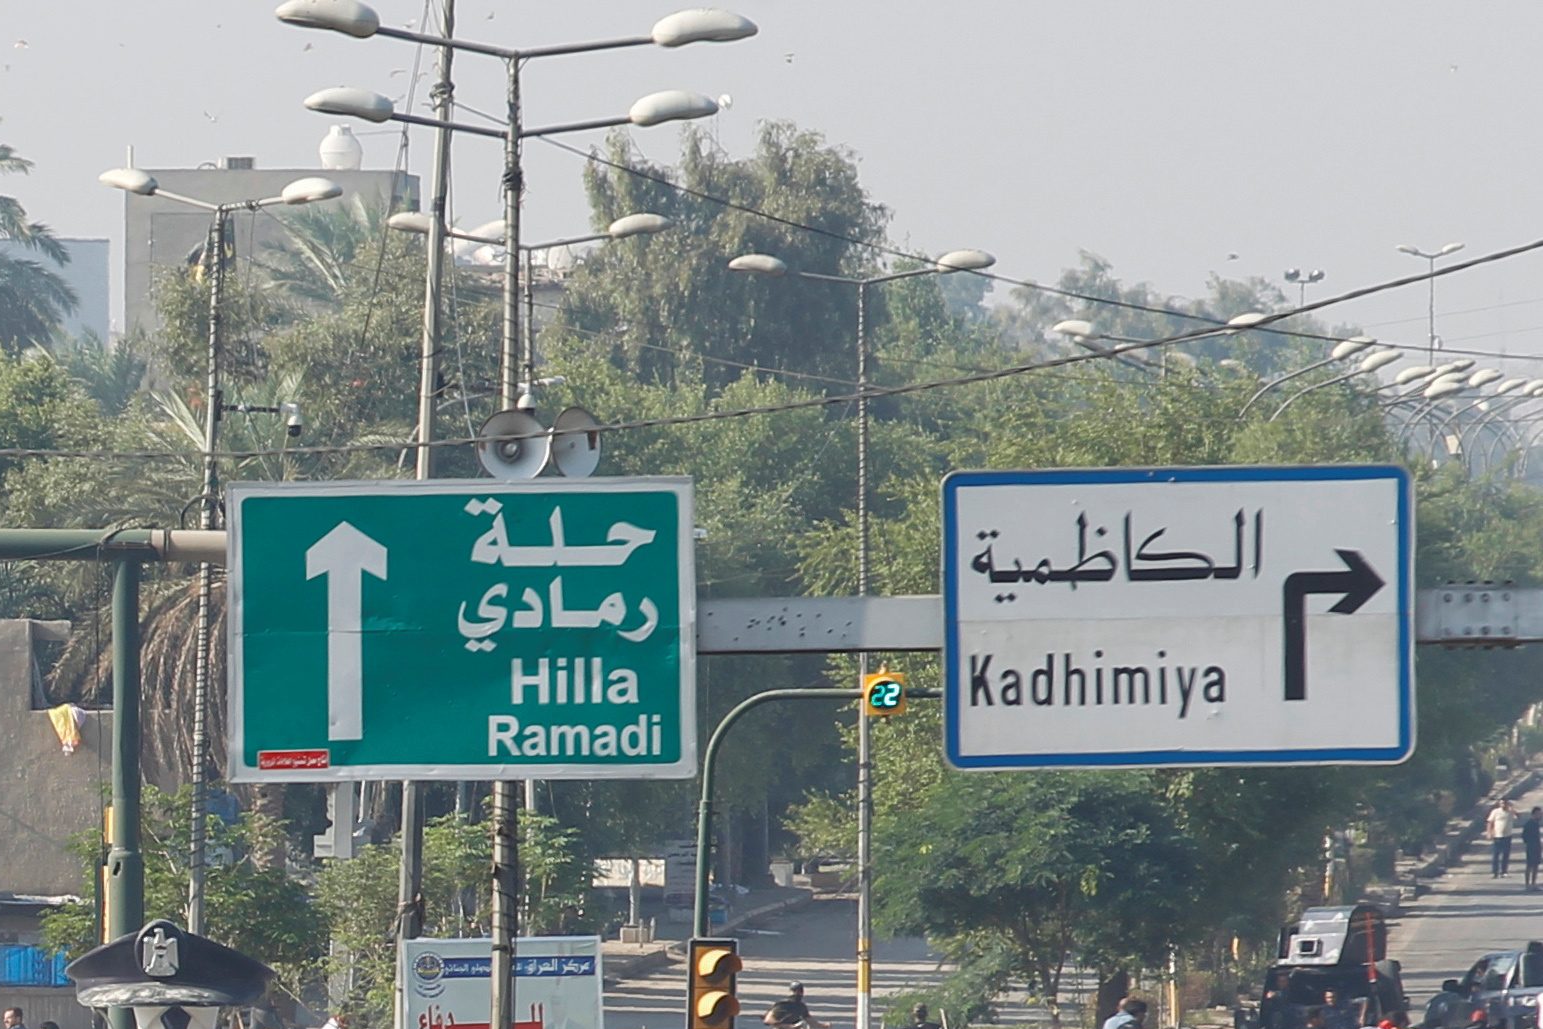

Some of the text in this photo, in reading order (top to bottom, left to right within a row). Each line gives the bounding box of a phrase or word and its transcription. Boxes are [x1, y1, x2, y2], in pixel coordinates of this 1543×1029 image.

[464, 497, 657, 567] حلة
[970, 507, 1264, 603] الكاظمية
[458, 575, 659, 652] رمادي
[510, 657, 640, 705] Hilla
[871, 683, 900, 706] 22
[968, 650, 1227, 719] Kadhimiya
[487, 714, 662, 757] Ramadi
[560, 958, 591, 975] مركز
